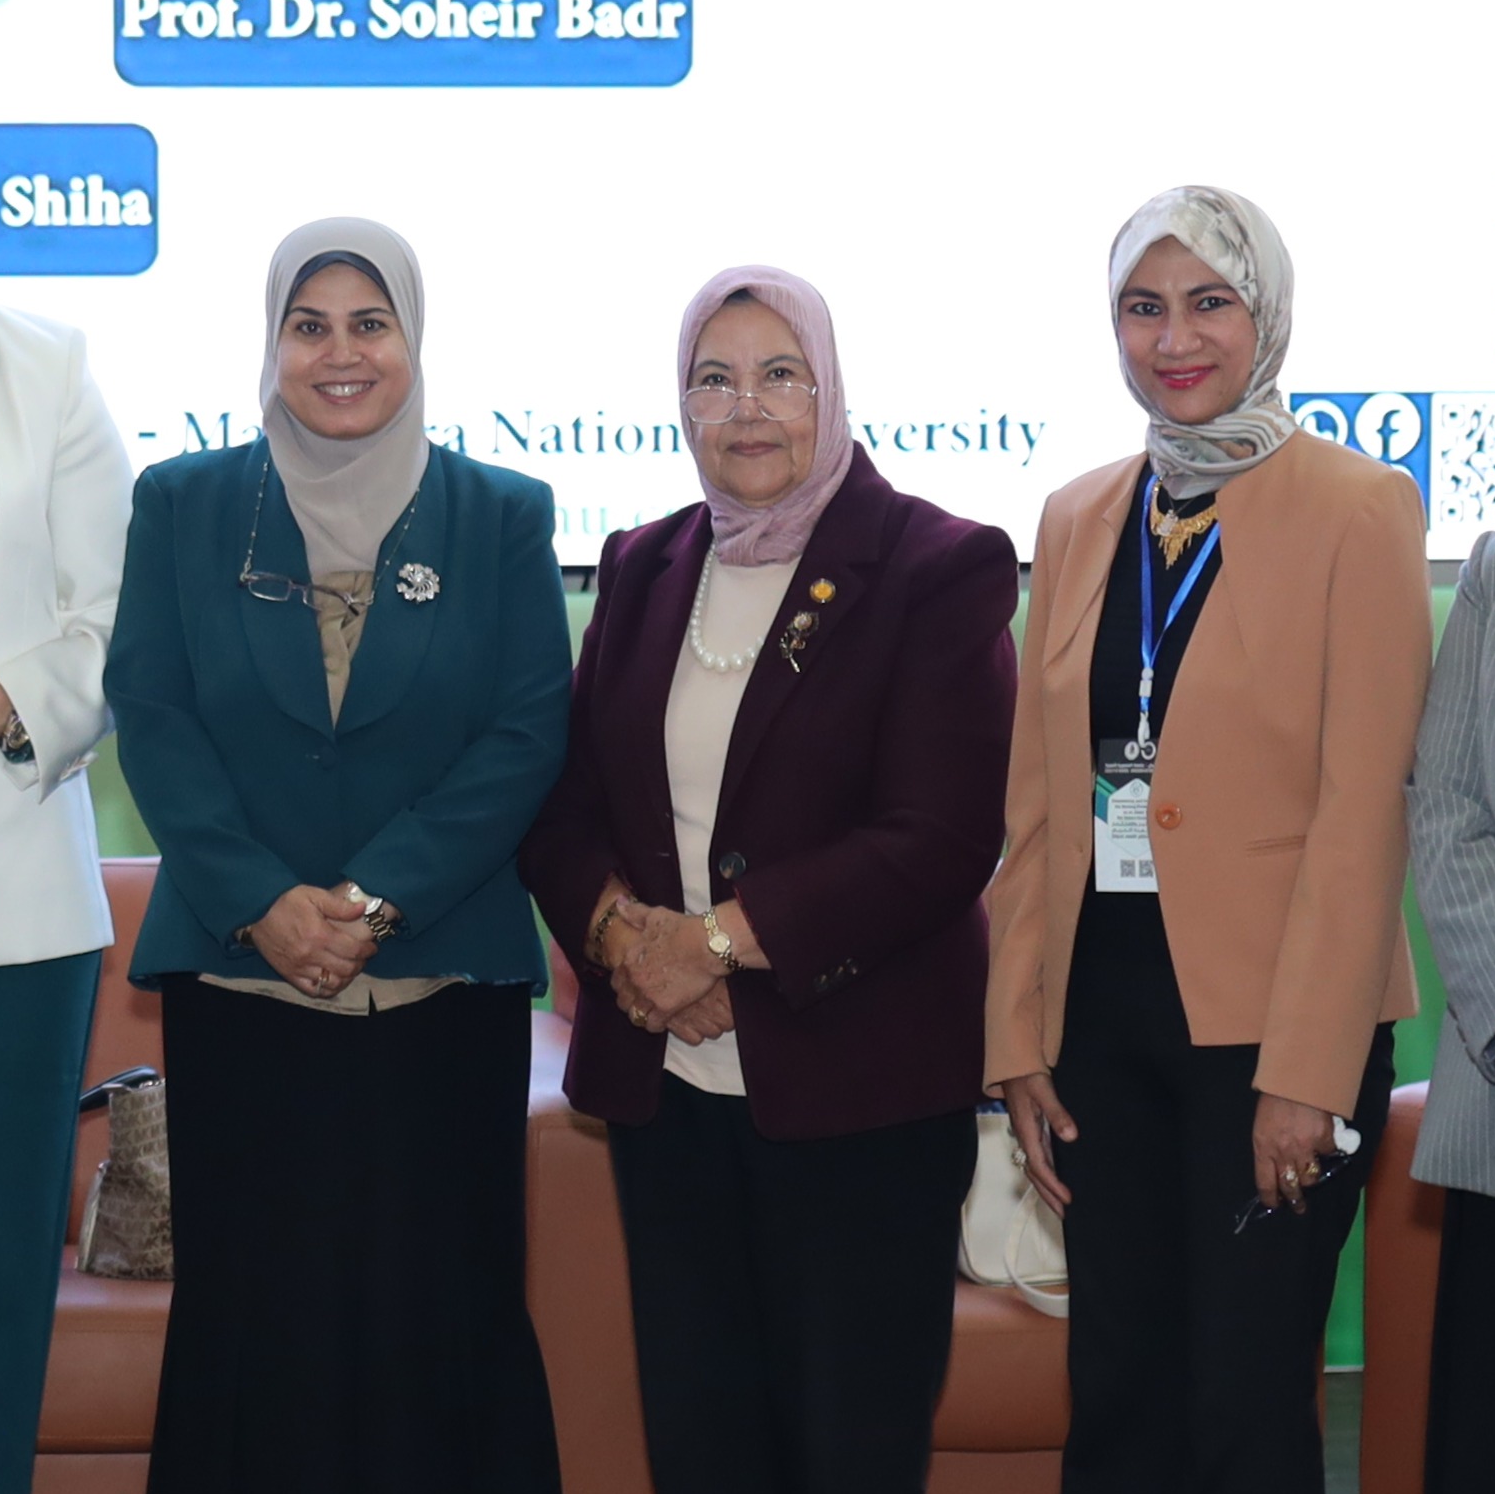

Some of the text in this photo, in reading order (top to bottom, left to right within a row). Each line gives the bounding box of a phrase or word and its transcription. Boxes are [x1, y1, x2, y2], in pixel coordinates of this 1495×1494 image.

[1, 175, 152, 228] Shiha
[491, 409, 681, 456] Nation
[848, 408, 1047, 467] versity
